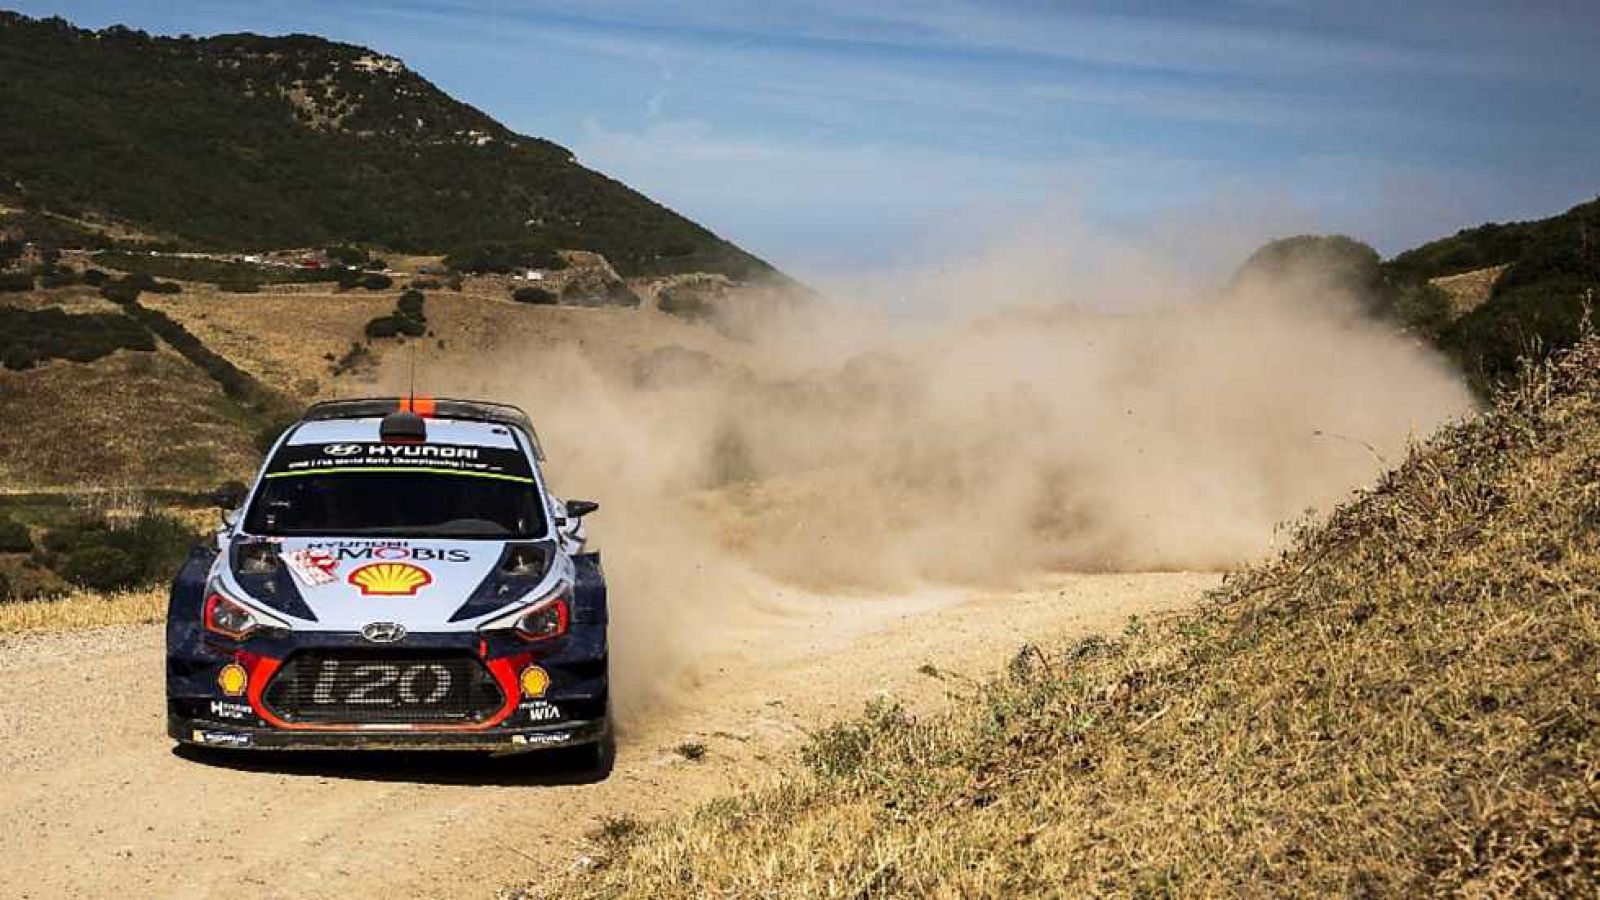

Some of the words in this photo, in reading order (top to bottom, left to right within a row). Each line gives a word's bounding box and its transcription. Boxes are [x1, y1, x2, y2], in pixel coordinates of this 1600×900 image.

[368, 445, 478, 458] HYUNDAI
[338, 548, 471, 562] MOBIS
[530, 706, 561, 720] WIA
